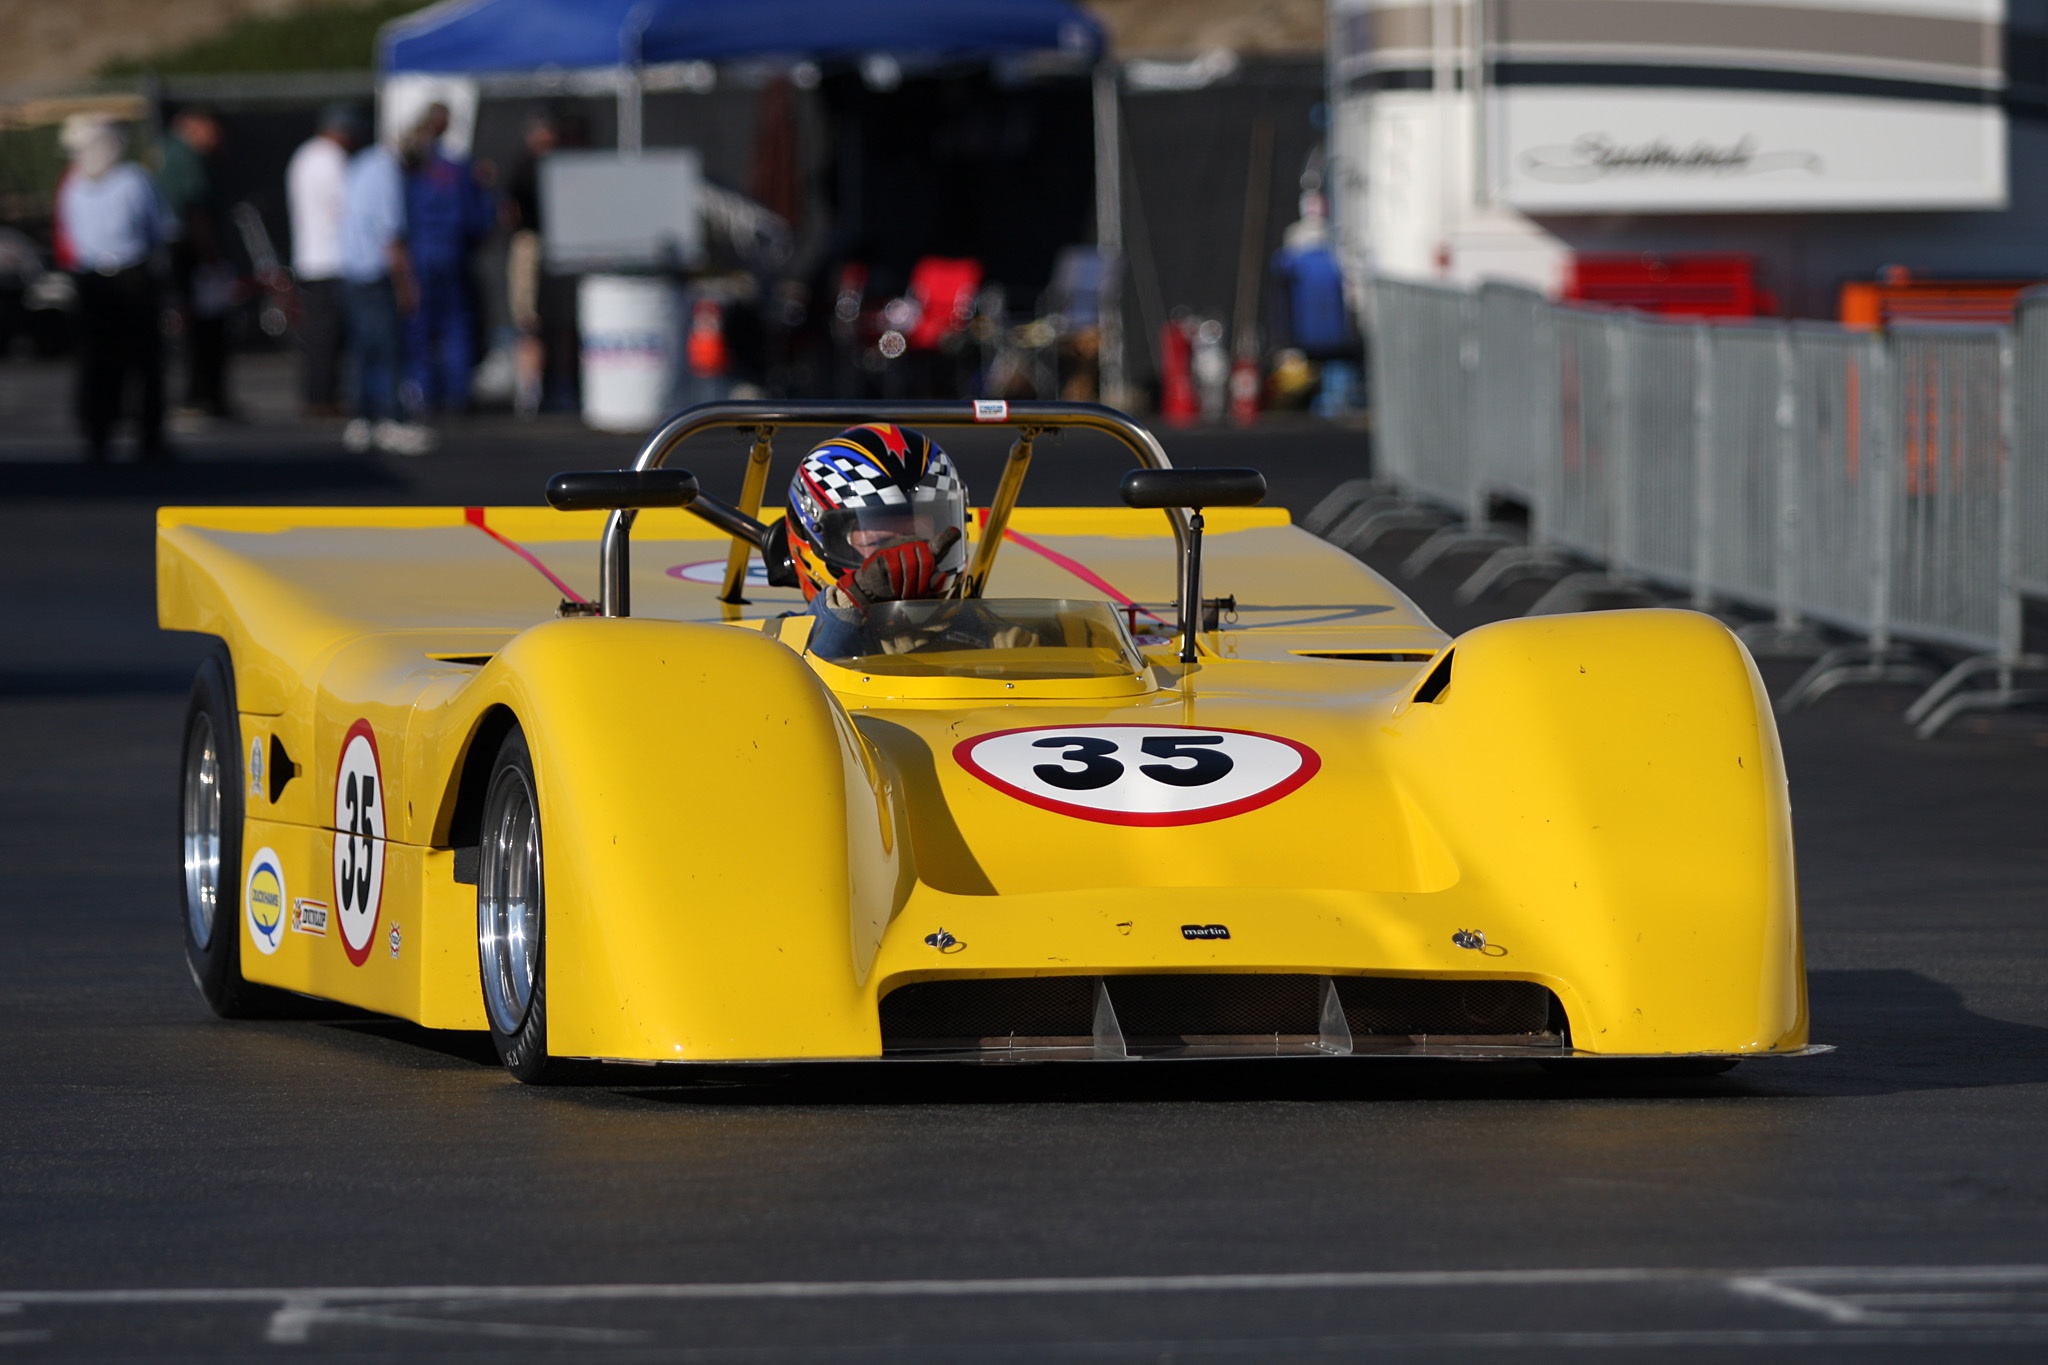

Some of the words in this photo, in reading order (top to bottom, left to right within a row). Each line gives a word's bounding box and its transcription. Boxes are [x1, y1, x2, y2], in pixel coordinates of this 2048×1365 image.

[1032, 735, 1234, 790] 35
[342, 770, 375, 914] 35
[302, 908, 326, 927] DUNLOP
[1184, 927, 1227, 935] martin
